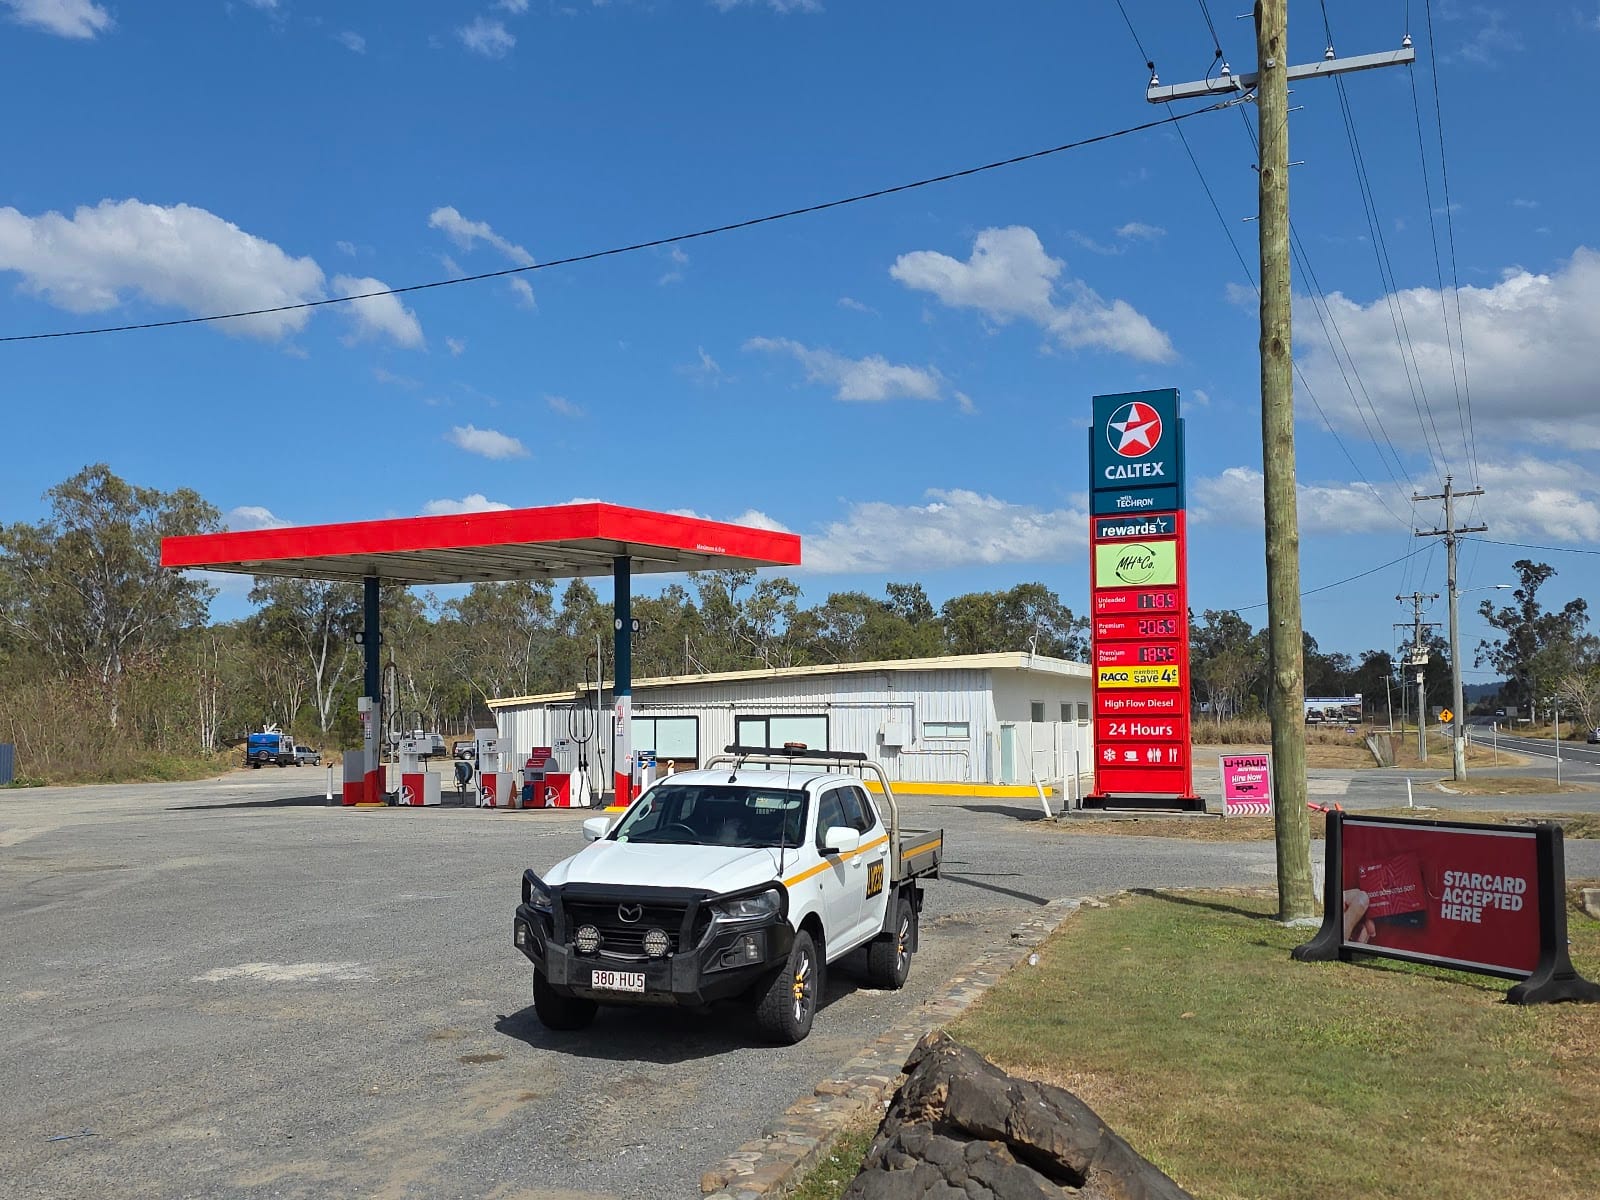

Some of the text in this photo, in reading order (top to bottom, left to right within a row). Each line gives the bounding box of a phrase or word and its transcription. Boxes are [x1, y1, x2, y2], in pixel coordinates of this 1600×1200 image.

[1105, 462, 1165, 480] CALTEX
[1116, 498, 1153, 508] TECHRON
[1102, 522, 1157, 537] rewards
[1100, 672, 1129, 682] RACQ
[1134, 674, 1159, 683] save
[1104, 700, 1125, 710] High
[1147, 698, 1174, 707] Diesel
[1108, 723, 1173, 736] 24 Hours
[1224, 759, 1267, 768] U-HAUL
[1247, 773, 1262, 782] Now
[1443, 870, 1527, 894] STARCARD
[1442, 887, 1523, 911] ACCEPTED
[1441, 903, 1482, 923] HERE
